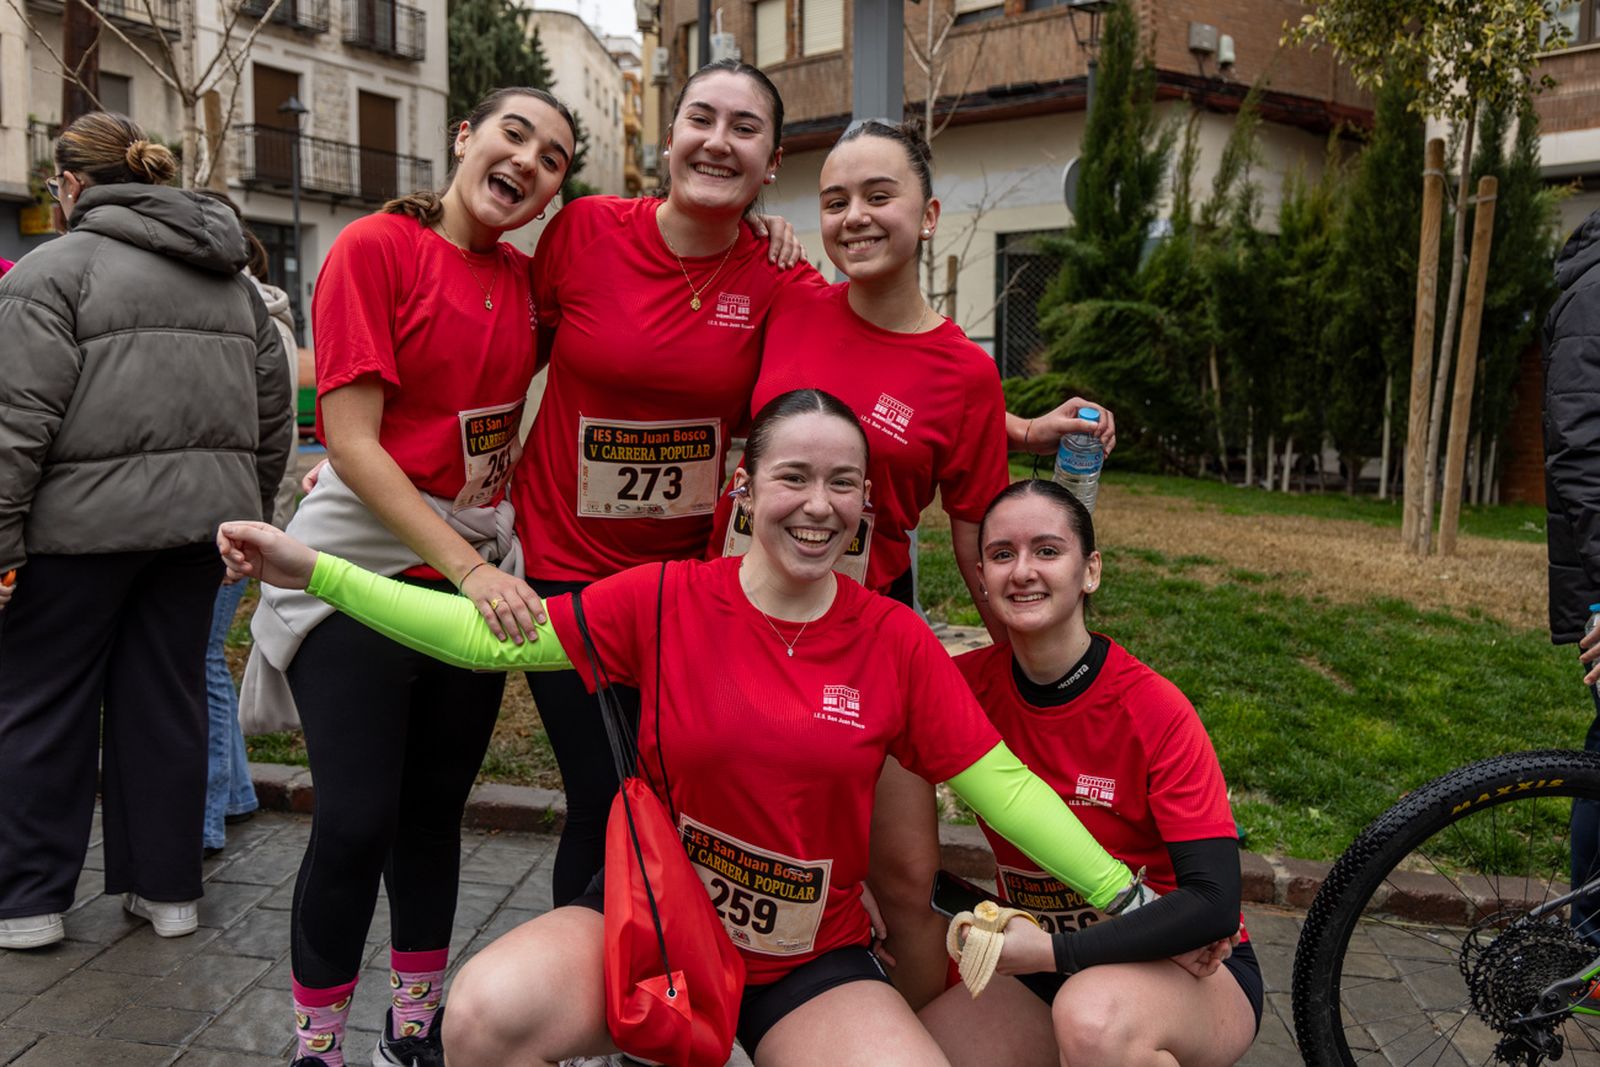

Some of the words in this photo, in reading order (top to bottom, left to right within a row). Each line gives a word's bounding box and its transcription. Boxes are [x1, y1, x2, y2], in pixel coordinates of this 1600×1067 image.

[470, 419, 484, 435] IES
[486, 417, 502, 432] San
[470, 437, 477, 453] V
[593, 428, 612, 442] IES
[616, 430, 639, 444] San
[642, 431, 670, 445] Juan
[673, 430, 707, 443] Bosco
[589, 444, 599, 458] V
[601, 444, 656, 461] CARRERA
[660, 443, 711, 461] POPULAR
[617, 465, 683, 502] 273
[1450, 779, 1565, 816] MAXXIS
[713, 839, 736, 860] San
[737, 851, 770, 875] Juan
[773, 864, 814, 883] Bosco
[687, 842, 695, 858] V
[697, 850, 750, 886] CARRERA
[754, 874, 816, 901] POPULAR
[1023, 878, 1041, 893] San
[1043, 879, 1067, 893] Jua
[709, 877, 778, 935] 259
[1017, 890, 1064, 909] CARRERA
